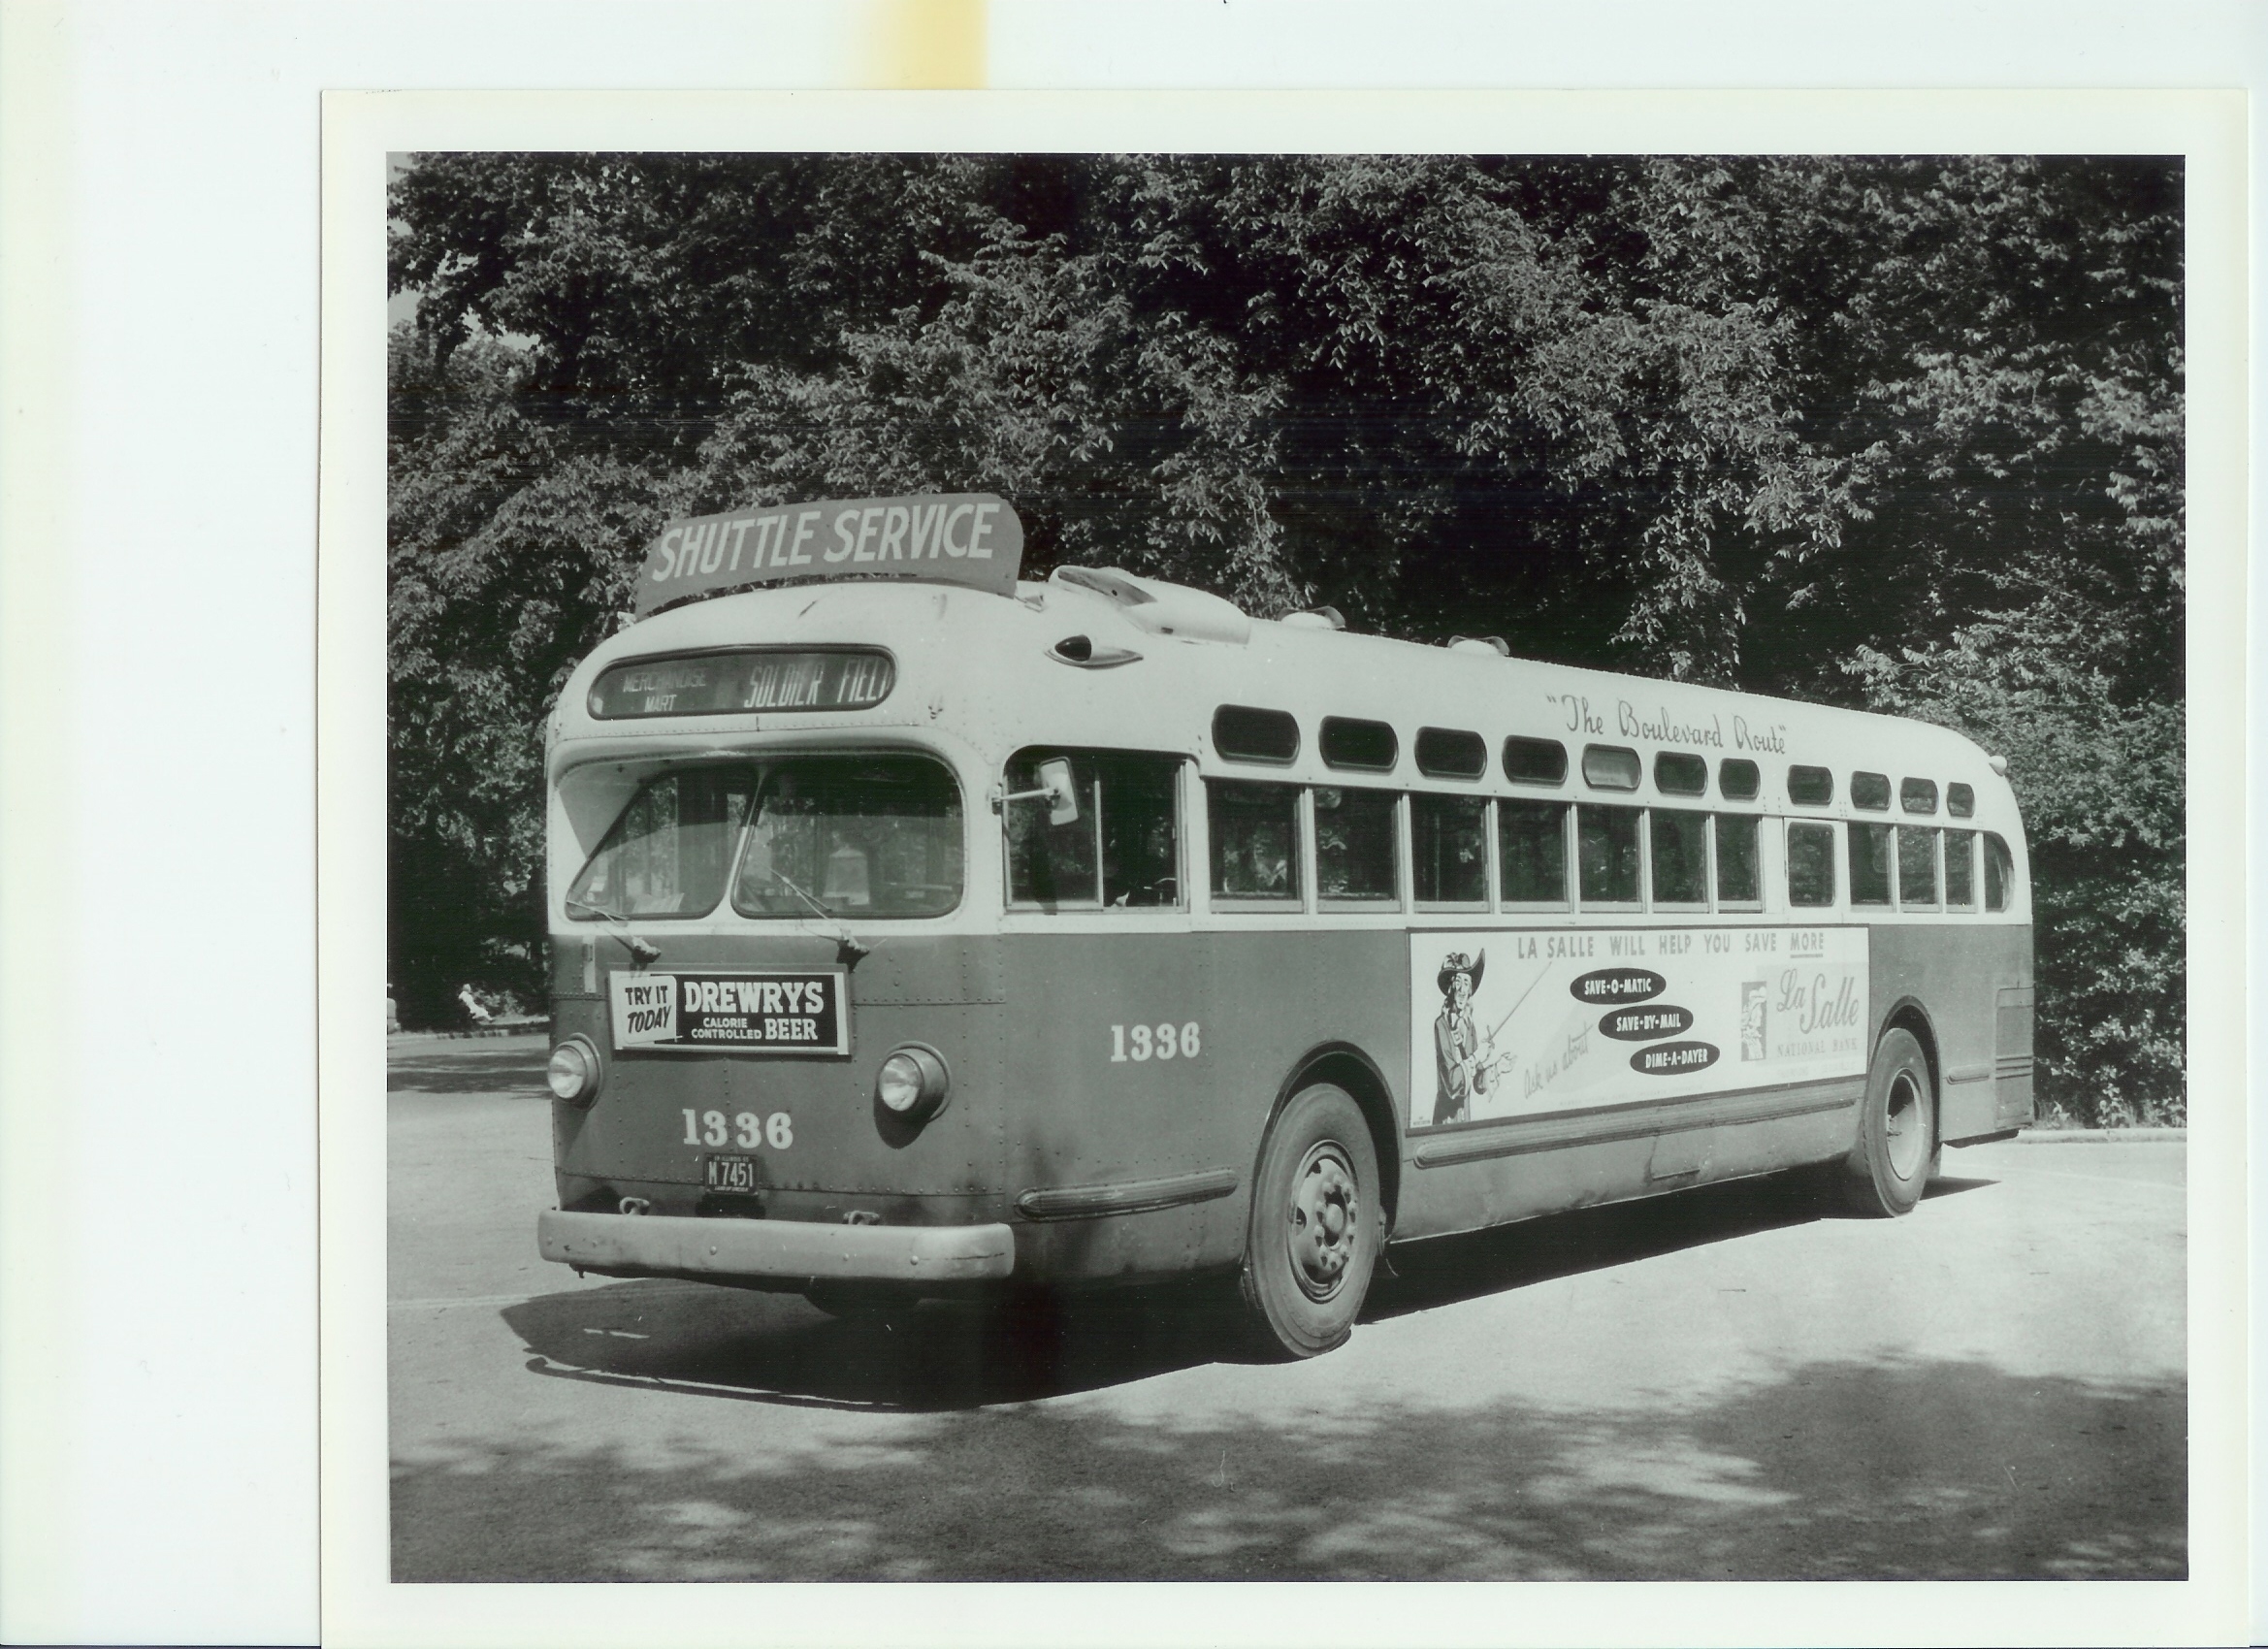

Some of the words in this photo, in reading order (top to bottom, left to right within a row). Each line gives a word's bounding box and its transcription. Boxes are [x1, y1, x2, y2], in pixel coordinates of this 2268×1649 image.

[652, 511, 821, 581] SHUTTLE
[824, 502, 1001, 563] SERVICE
[743, 663, 825, 709] SOLDIER
[644, 694, 678, 713] MART
[1617, 699, 1724, 748] Boulevard
[1517, 936, 1539, 959] LA
[1547, 935, 1595, 959] SALLE
[1609, 934, 1646, 956] WILL
[1659, 934, 1692, 955] HELP
[1703, 932, 1732, 954] YOU
[1745, 932, 1777, 953] SAVE
[1789, 931, 1825, 952] MORE
[625, 986, 652, 1006] TRY
[656, 986, 668, 1004] IT
[683, 981, 824, 1014] DREWRYS
[1776, 968, 1805, 1012] La
[1799, 973, 1860, 1034] Salle
[627, 1005, 671, 1034] TODAY
[702, 1017, 748, 1029] CALORIE
[763, 1018, 819, 1041] BEER
[691, 1027, 762, 1041] CONTROLLED
[1110, 1020, 1201, 1062] 1336
[1776, 1040, 1825, 1057] NATIONAL
[1832, 1037, 1858, 1051] BANK
[682, 1109, 794, 1149] 1336
[721, 1161, 753, 1187] 7451
